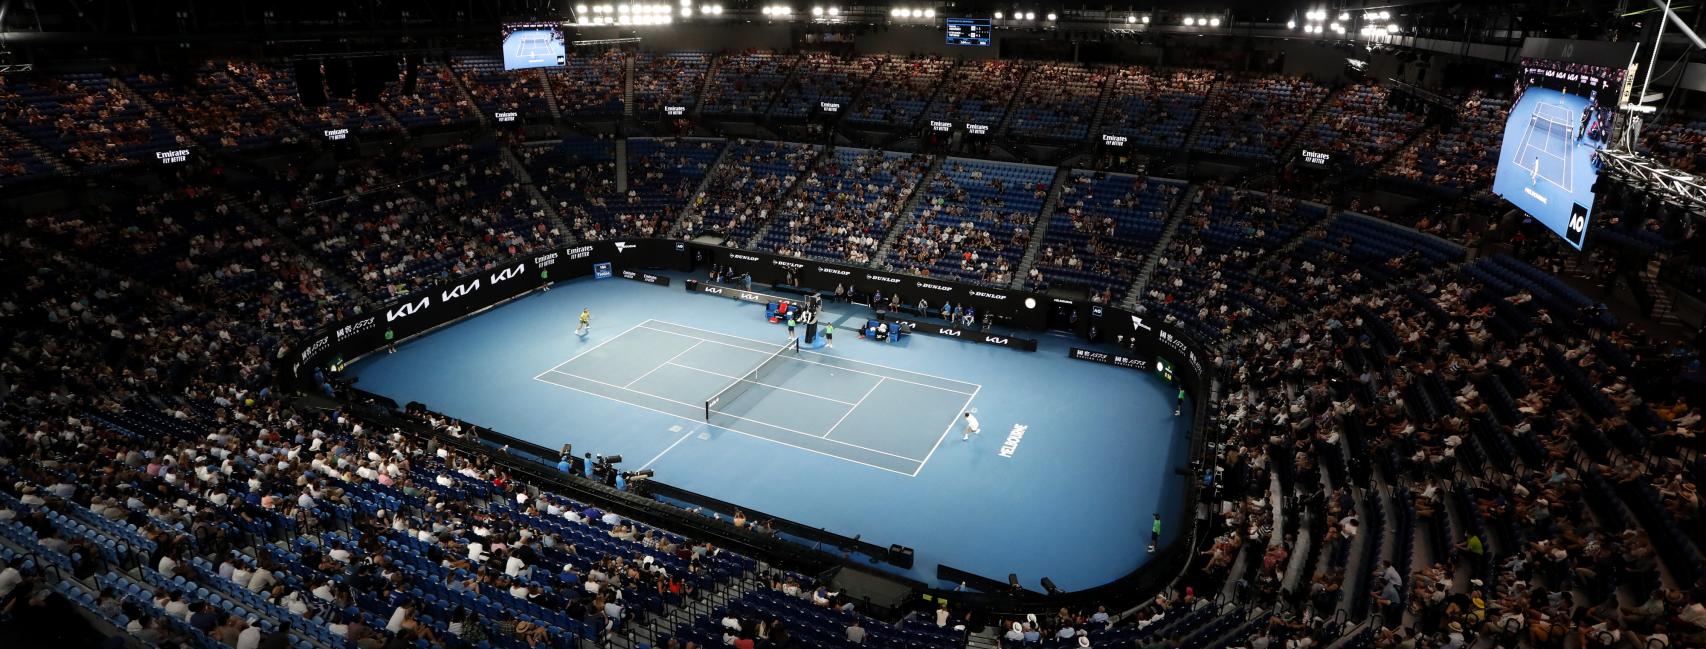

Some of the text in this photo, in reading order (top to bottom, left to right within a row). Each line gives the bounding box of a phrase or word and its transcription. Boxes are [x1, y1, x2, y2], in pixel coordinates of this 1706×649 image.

[324, 128, 349, 136] Emirates
[156, 150, 190, 158] Emirates
[1302, 150, 1330, 160] Emirates
[1569, 213, 1584, 233] AO
[567, 246, 593, 255] Emirates
[534, 252, 558, 264] Emirates
[491, 264, 525, 284] KIA
[442, 279, 480, 302] KIA
[922, 283, 952, 291] DUNLOP
[975, 292, 1006, 300] DUNLOP
[387, 296, 430, 322] KIA
[998, 424, 1028, 458] MELBOURNE
